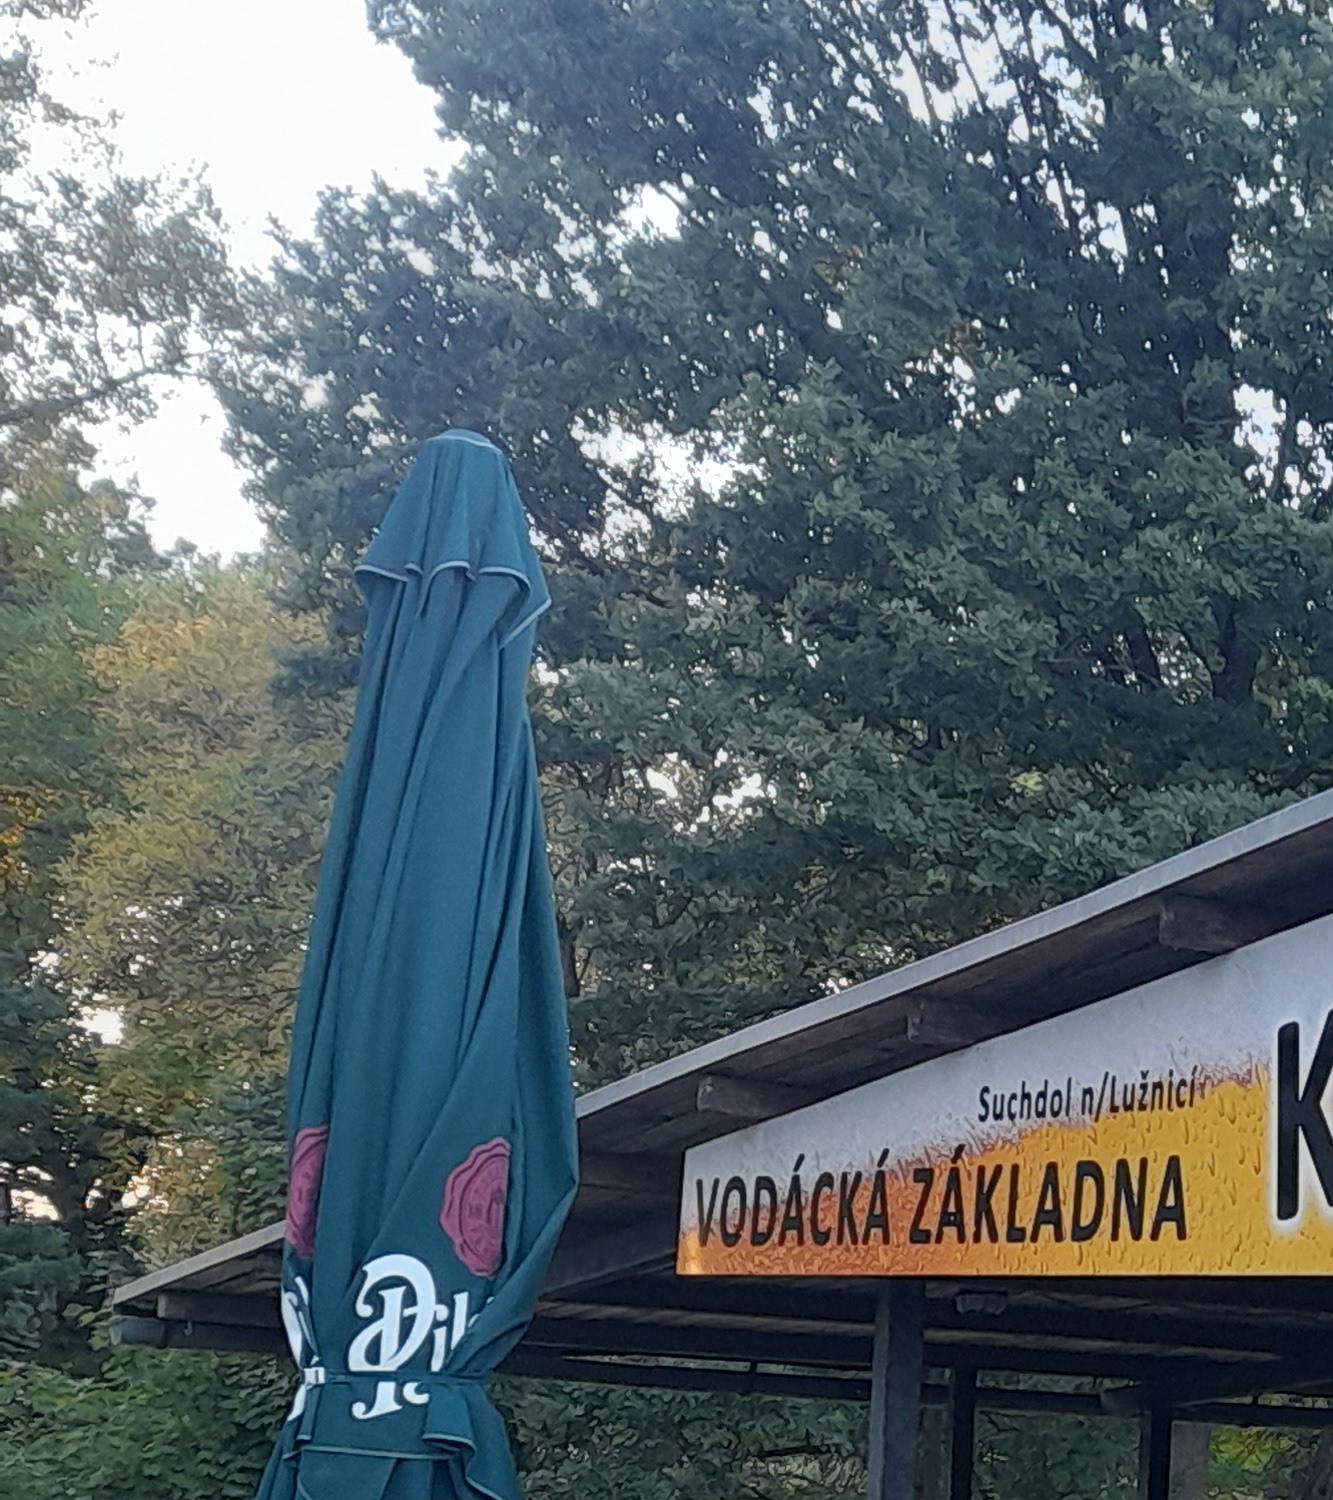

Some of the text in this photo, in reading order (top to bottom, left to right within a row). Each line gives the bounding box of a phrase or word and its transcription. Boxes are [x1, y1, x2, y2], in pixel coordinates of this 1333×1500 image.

[977, 1064, 1198, 1123] Suchdol n/Lužnicí
[695, 1143, 1190, 1248] VODÁCKÁ ZÁKLADNA
